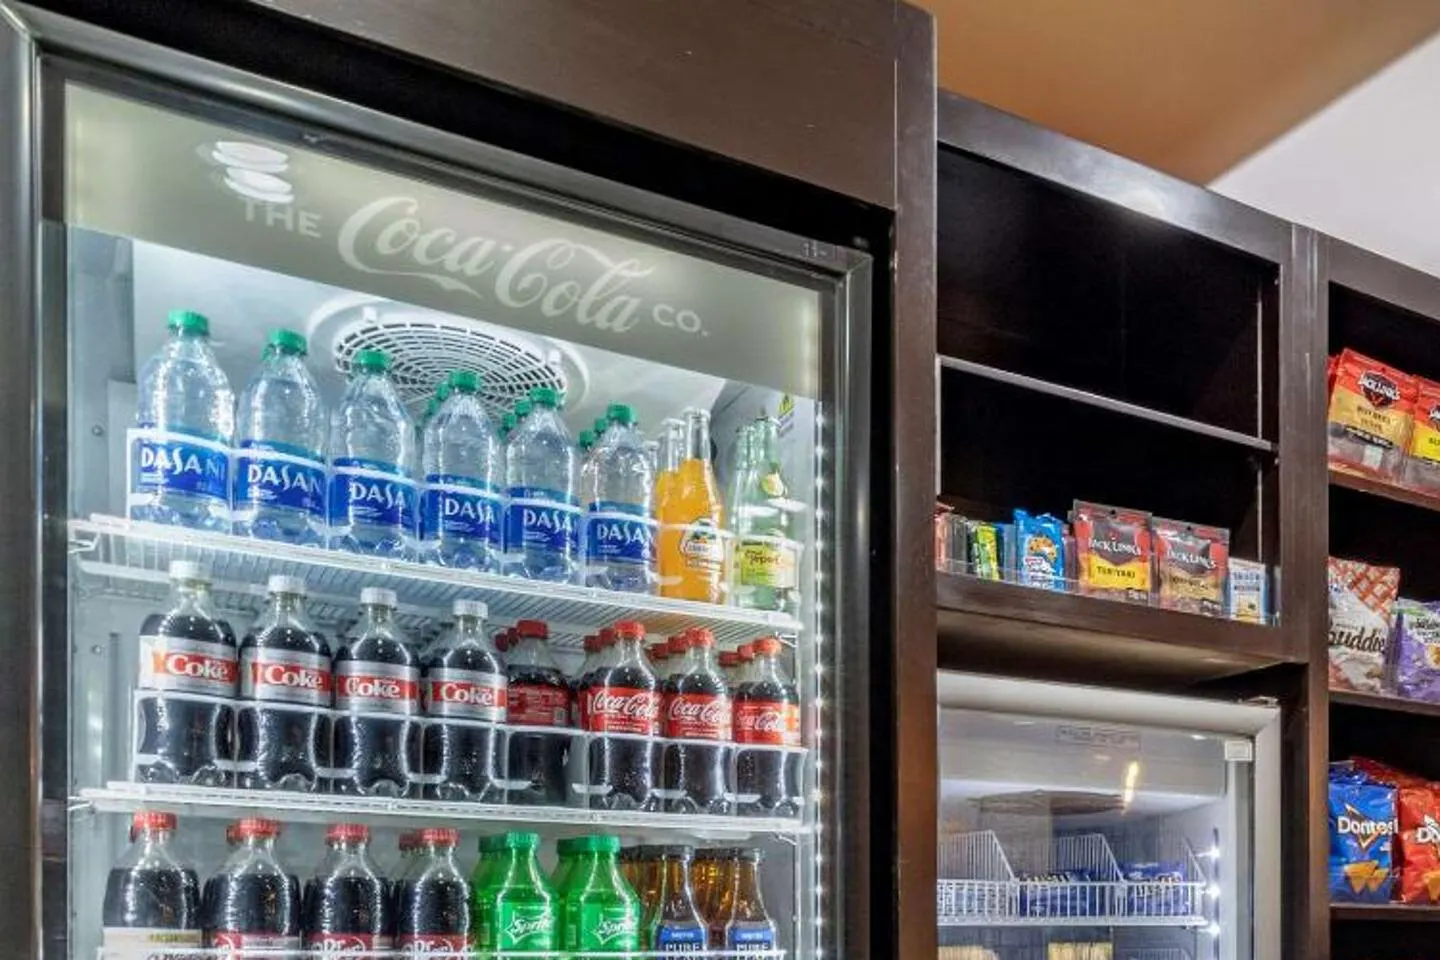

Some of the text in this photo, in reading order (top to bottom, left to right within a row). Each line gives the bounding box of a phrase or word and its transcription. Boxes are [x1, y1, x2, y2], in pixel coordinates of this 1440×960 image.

[243, 198, 322, 238] THE
[652, 303, 709, 337] CO.
[140, 446, 226, 483] DASANI
[166, 654, 229, 678] Coke
[264, 664, 323, 688] Coke
[346, 676, 401, 698] Coke
[441, 682, 493, 706] Coke
